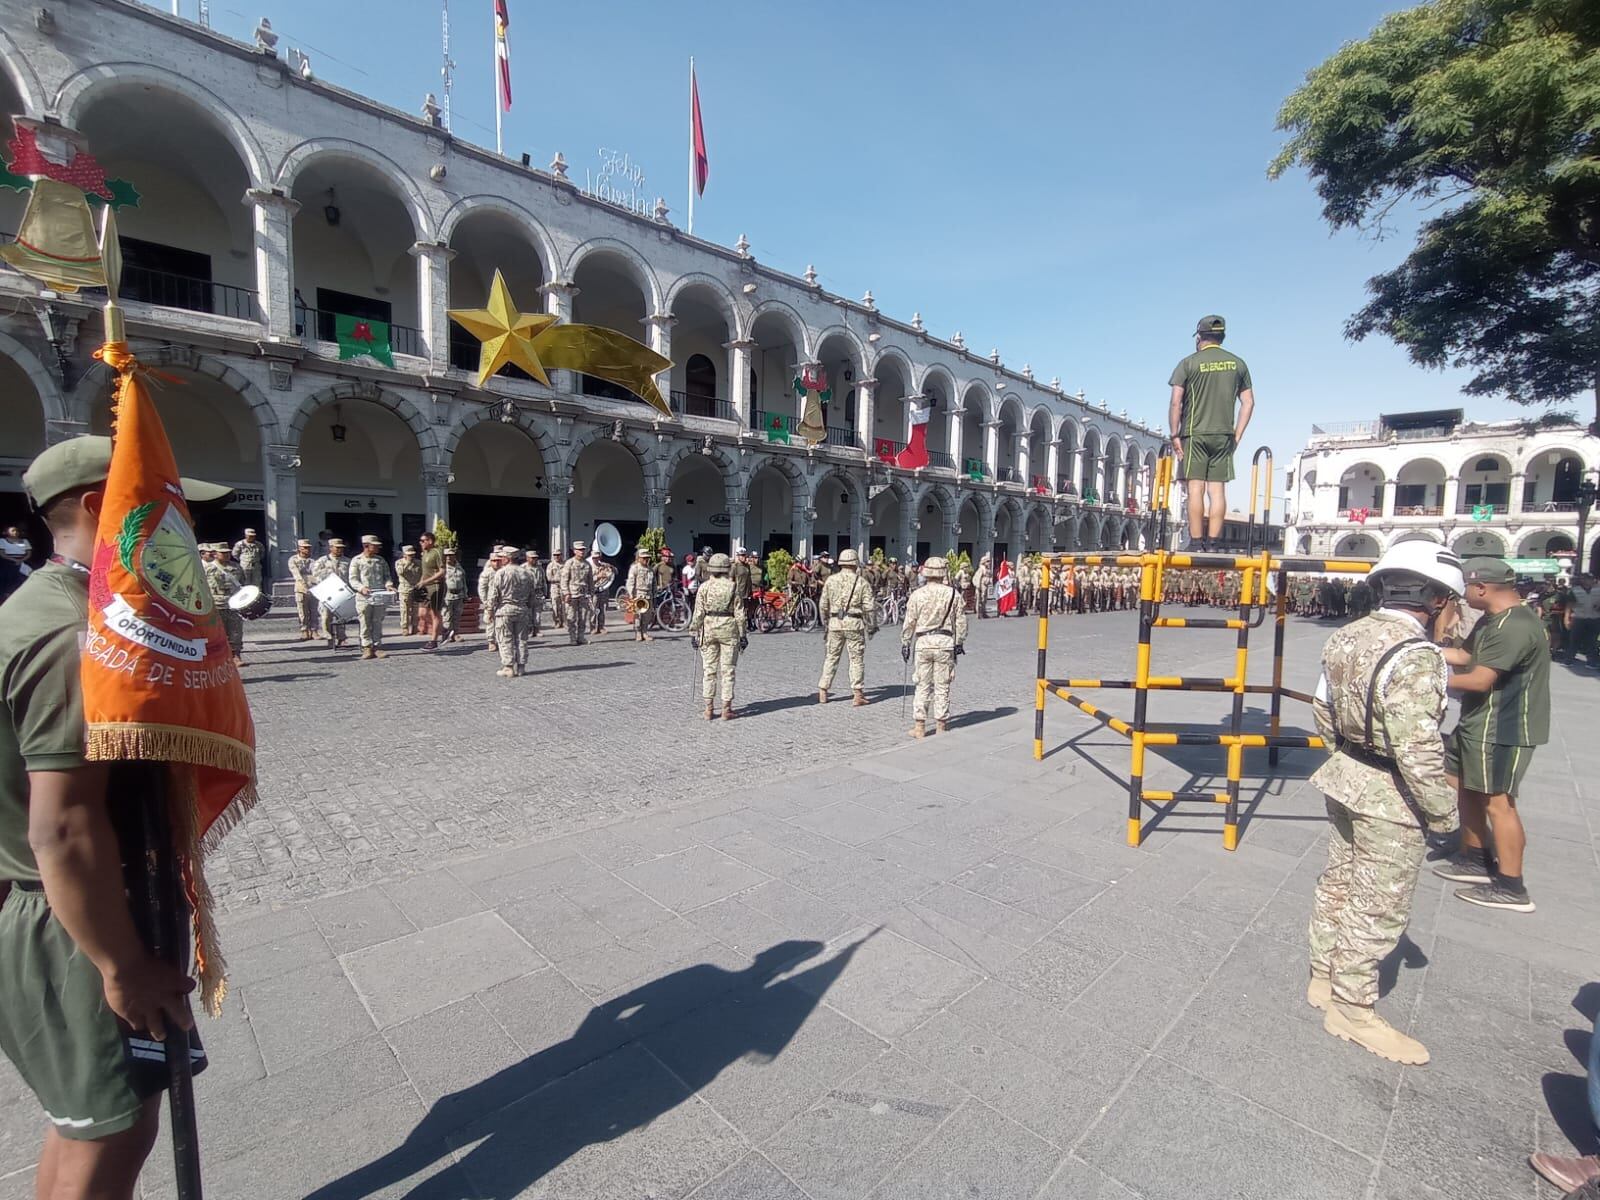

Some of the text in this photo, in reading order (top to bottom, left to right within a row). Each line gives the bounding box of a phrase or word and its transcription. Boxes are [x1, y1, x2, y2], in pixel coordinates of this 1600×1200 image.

[1200, 361, 1237, 373] EJERCITO
[118, 618, 198, 657] OPORTUNIDAD
[146, 662, 175, 685] DE
